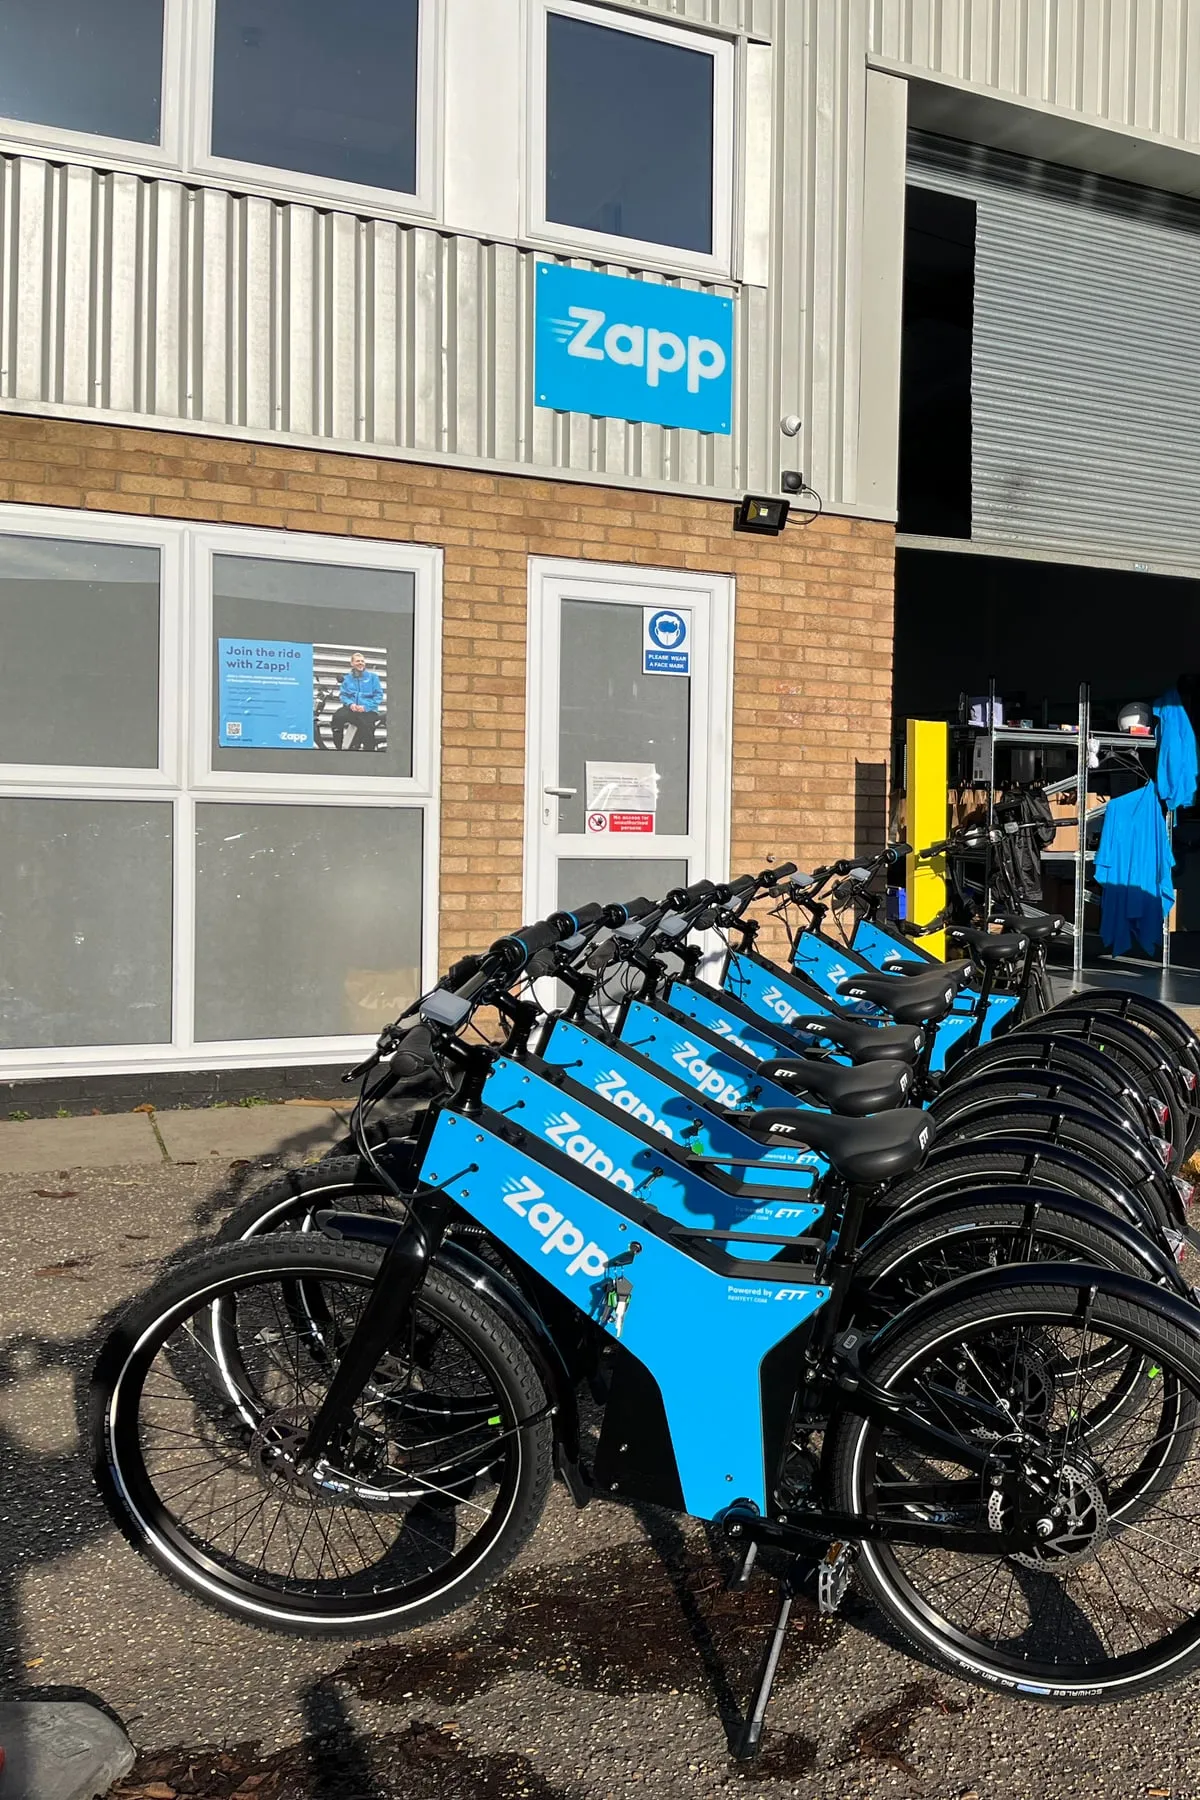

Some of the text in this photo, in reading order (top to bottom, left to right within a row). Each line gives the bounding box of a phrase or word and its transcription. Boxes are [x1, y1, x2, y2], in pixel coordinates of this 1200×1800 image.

[567, 305, 726, 393] Zapp
[226, 646, 301, 659] Join the ride
[227, 658, 290, 673] with Zapp!
[280, 731, 308, 742] Zapp
[806, 1022, 827, 1031] ETT
[710, 1016, 763, 1061] Za
[672, 1040, 741, 1108] Zapp
[774, 1068, 798, 1078] ETT
[769, 1123, 797, 1133] ETT
[764, 1153, 786, 1161] owered
[765, 1208, 774, 1216] by
[774, 1208, 805, 1218] ETT
[502, 1175, 609, 1277] Zapp
[727, 1285, 811, 1300] Powered by ETT
[1053, 1688, 1103, 1697] SCHWALBE
